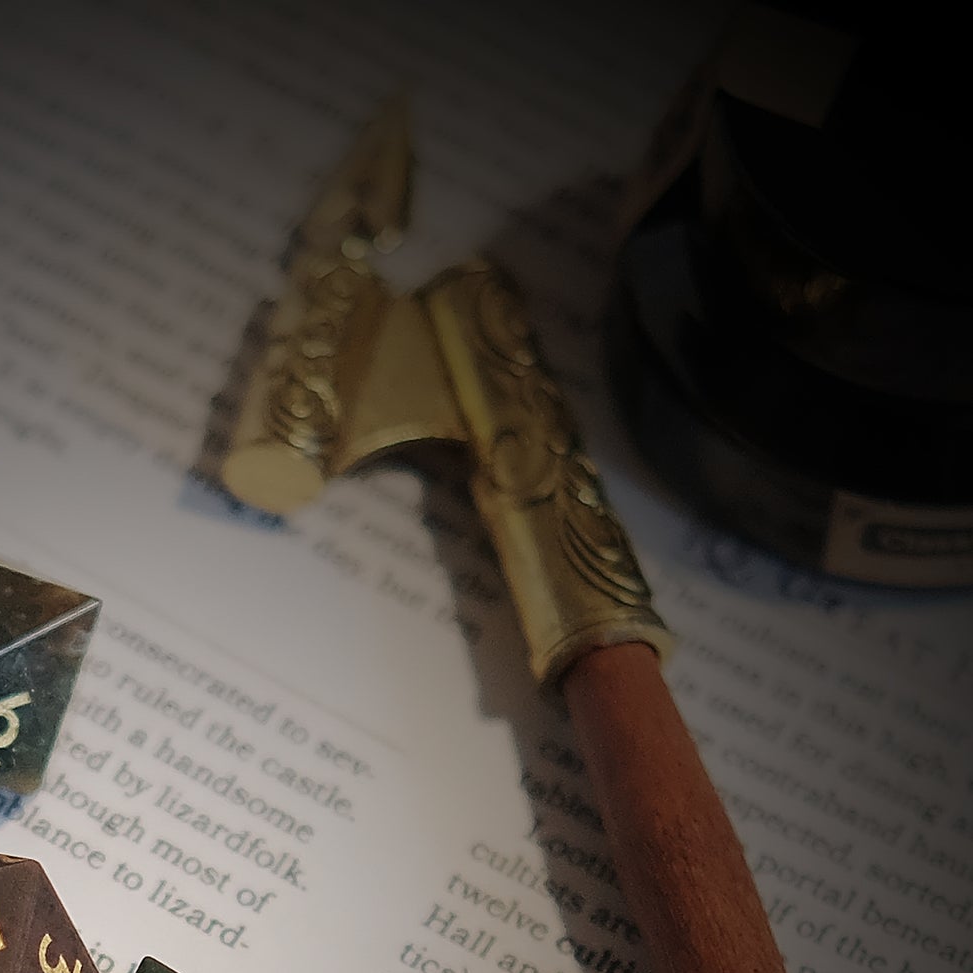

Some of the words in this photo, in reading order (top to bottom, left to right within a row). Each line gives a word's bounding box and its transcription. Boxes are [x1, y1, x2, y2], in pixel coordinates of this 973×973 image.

[120, 673, 202, 729] ruled
[260, 758, 356, 821] castle.
[155, 737, 315, 840] handsome
[150, 838, 232, 894] most
[235, 887, 278, 914] of
[154, 785, 307, 892] lizardfolk.
[111, 861, 144, 892] to
[147, 879, 250, 950] lizard-
